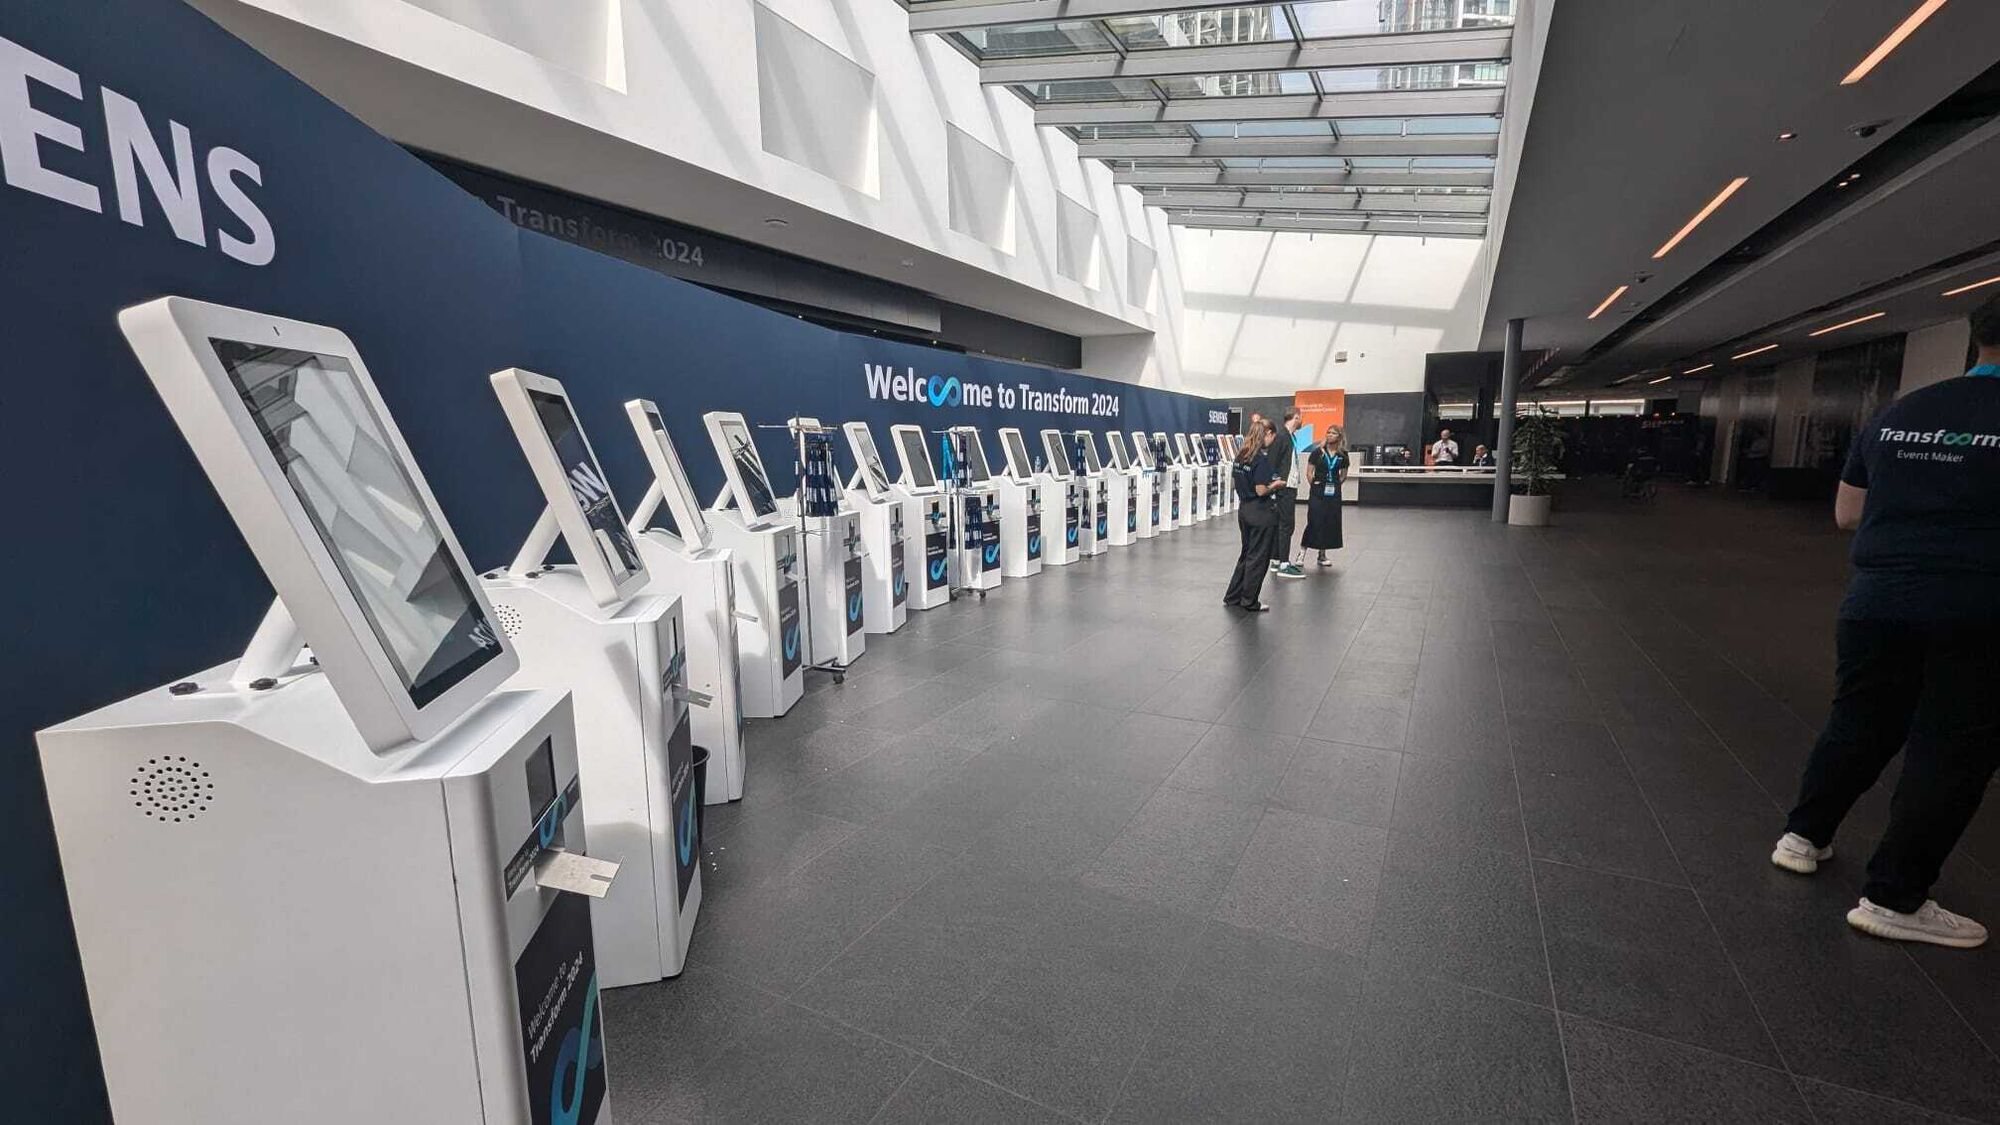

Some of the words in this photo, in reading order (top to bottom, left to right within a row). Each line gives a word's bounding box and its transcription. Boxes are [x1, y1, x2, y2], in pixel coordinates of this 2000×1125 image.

[997, 383, 1016, 410] to
[1018, 384, 1089, 415] Transform
[1091, 393, 1119, 417] 2024
[1208, 410, 1228, 425] SIEMENS
[1897, 449, 1929, 461] Event
[1931, 451, 1964, 463] Maker
[528, 976, 560, 1040] Welcome
[530, 987, 568, 1064] Transform
[567, 951, 583, 991] 2024
